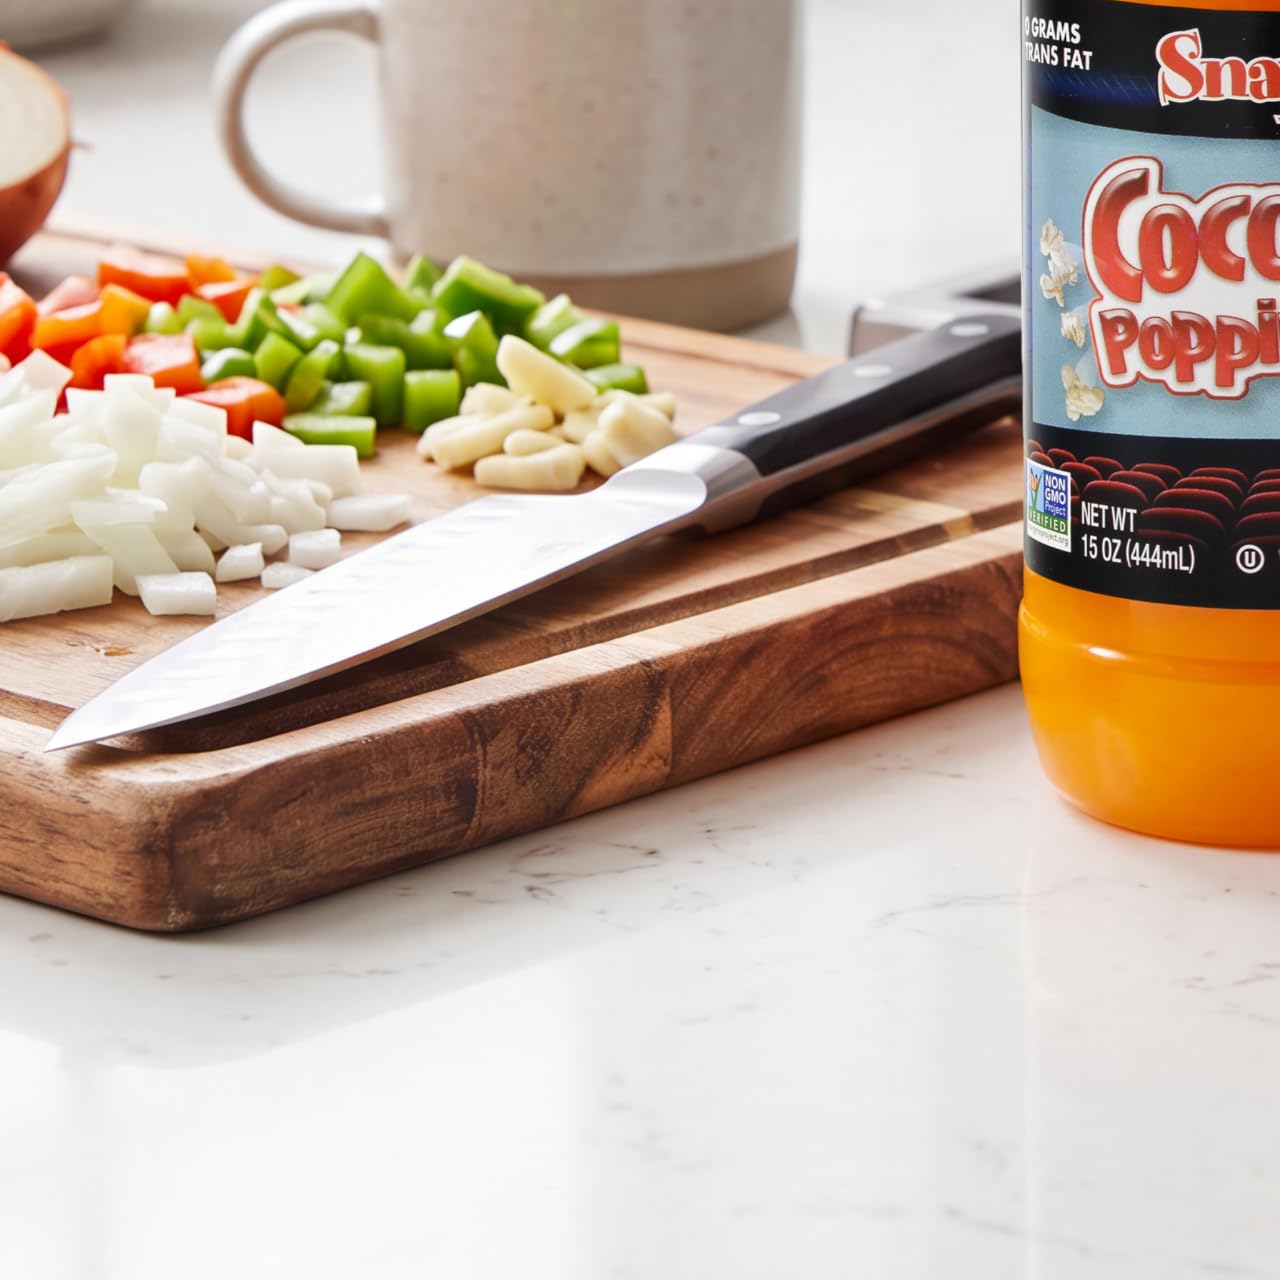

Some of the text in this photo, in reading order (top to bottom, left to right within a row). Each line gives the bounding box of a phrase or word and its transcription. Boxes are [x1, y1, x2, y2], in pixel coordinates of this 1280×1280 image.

[1031, 16, 1081, 44] GRAMS
[1025, 41, 1093, 71] TRANS FAT
[1045, 473, 1066, 492] NON
[1045, 488, 1067, 505] GMO
[1045, 500, 1067, 517] Project
[1081, 500, 1138, 533] NET WT
[1081, 535, 1098, 559] 15
[1101, 538, 1122, 563] OZ
[1125, 538, 1196, 574] (444mL)
